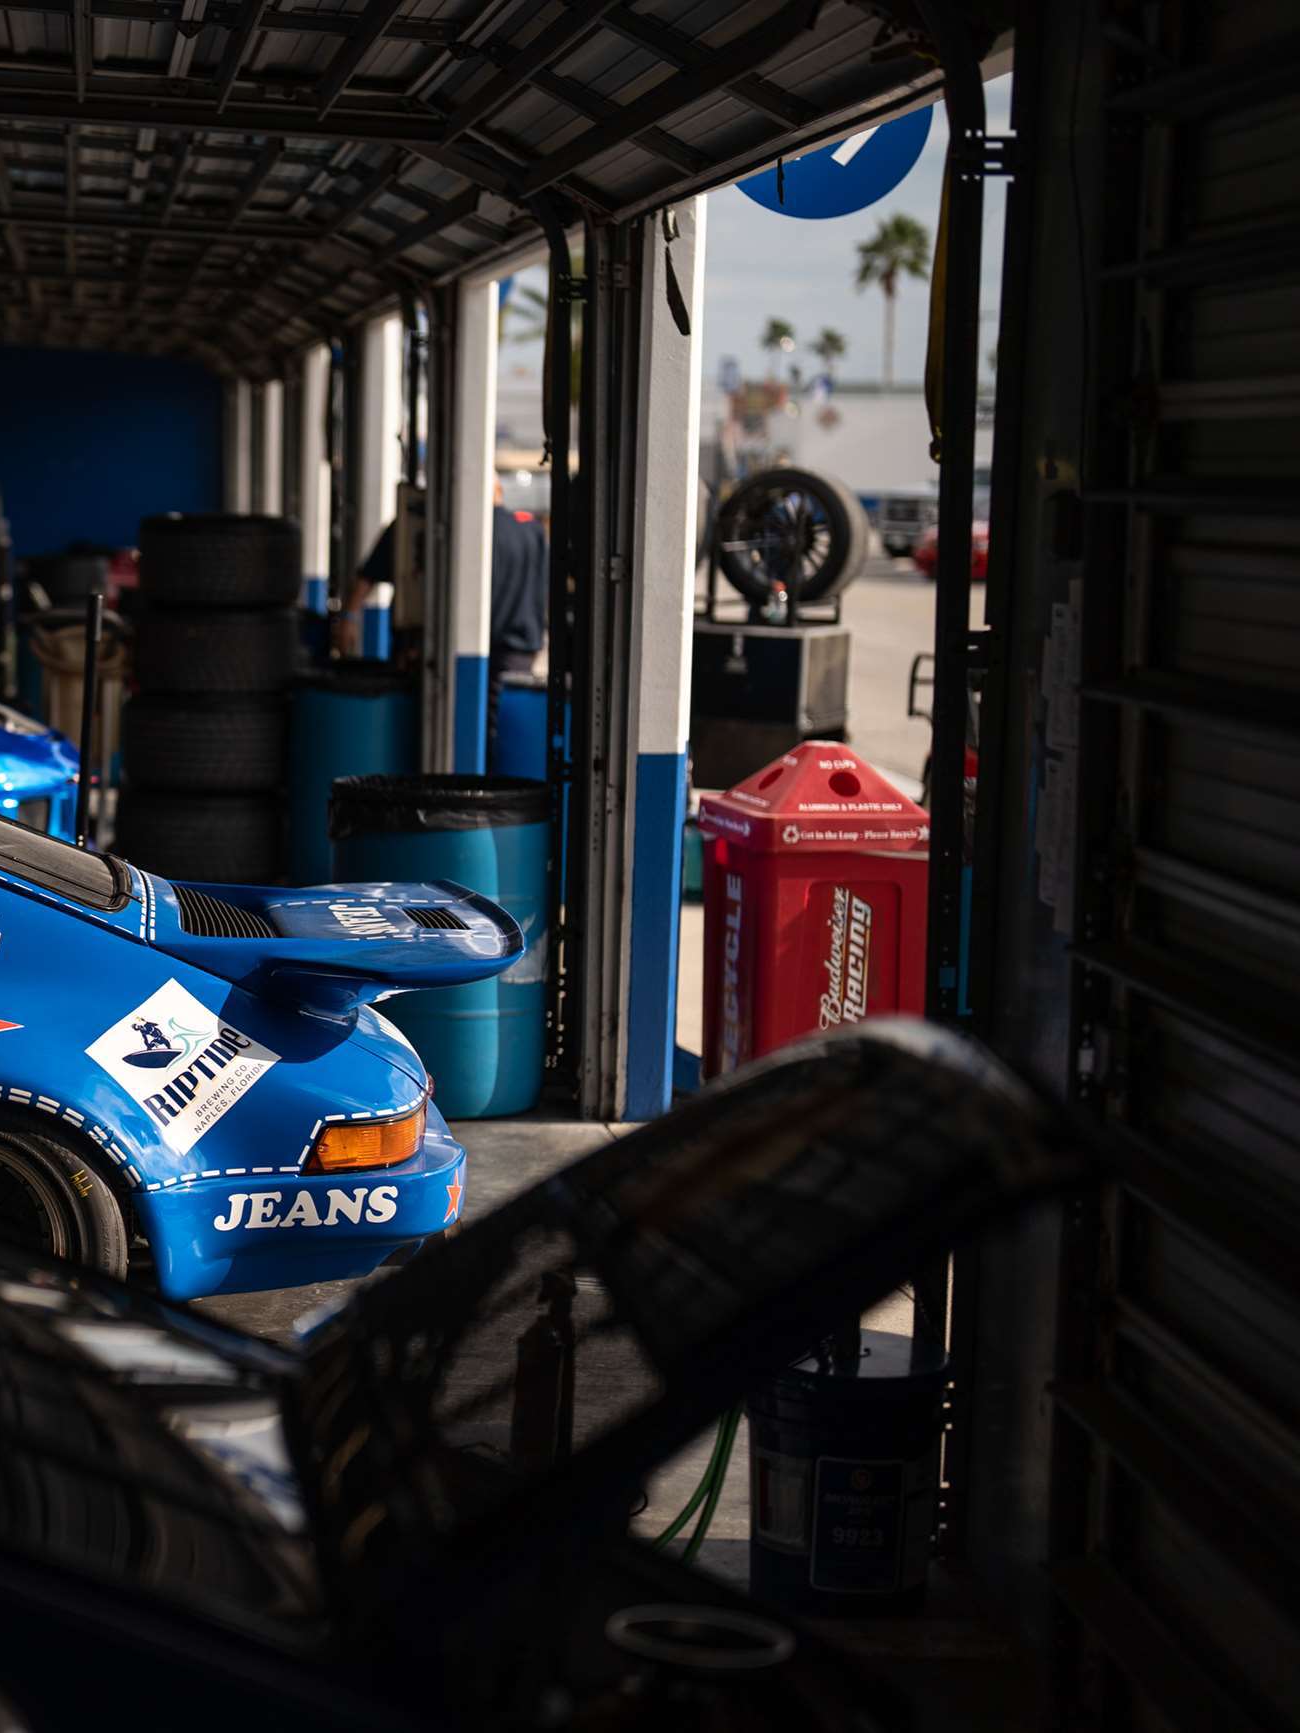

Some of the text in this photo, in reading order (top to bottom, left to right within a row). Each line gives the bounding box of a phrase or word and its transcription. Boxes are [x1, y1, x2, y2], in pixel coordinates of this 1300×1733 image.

[824, 830, 838, 840] the
[819, 886, 848, 1031] Budweiser
[195, 1077, 235, 1118] BREWING
[231, 1062, 265, 1097] FLORIDA
[213, 1185, 399, 1232] JEANS
